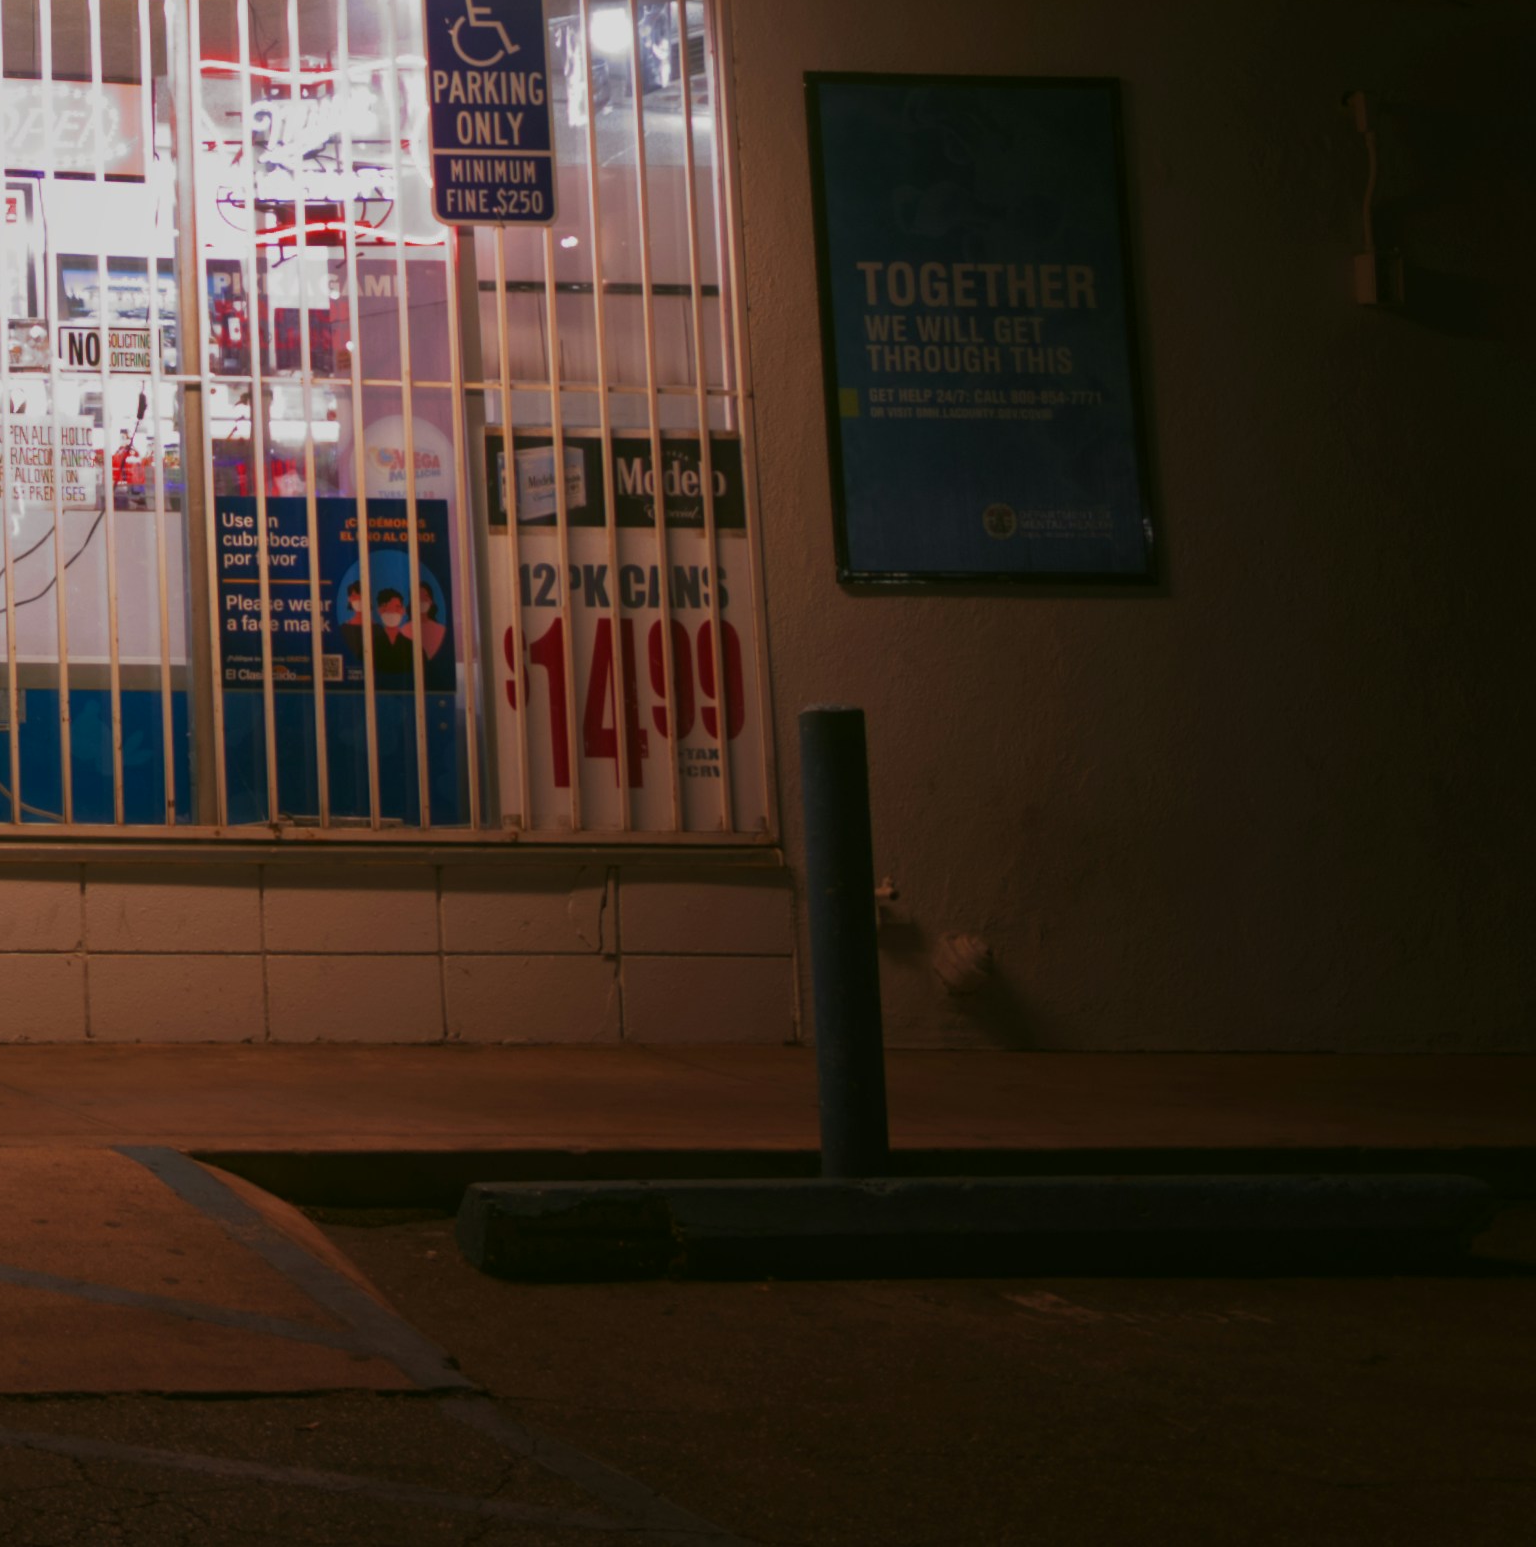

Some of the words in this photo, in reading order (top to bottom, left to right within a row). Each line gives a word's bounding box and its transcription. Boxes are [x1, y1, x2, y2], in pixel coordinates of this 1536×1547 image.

[433, 70, 544, 106] PARKING
[456, 110, 524, 145] ONLY
[450, 159, 536, 184] MINIMUM
[446, 188, 489, 212] FINE
[496, 187, 543, 216] $250
[856, 261, 1097, 309] TOGETHER
[864, 314, 907, 342] WE
[916, 315, 984, 343] WILL
[993, 316, 1044, 344] GET
[69, 331, 101, 367] NO
[108, 352, 151, 368] OITERING
[866, 345, 1001, 374] THROUGH
[1009, 346, 1073, 375] THIS
[869, 388, 895, 403] GET
[898, 388, 932, 403] HELP
[974, 389, 1008, 404] CALL
[31, 426, 93, 447] ALCHOLIC
[14, 467, 62, 484] ALLOWE
[617, 457, 727, 498] Modeo
[222, 513, 254, 528] Use
[224, 553, 251, 569] por
[520, 563, 611, 608] 12PK
[619, 564, 730, 610] CANS
[226, 594, 284, 612] Pleae
[289, 598, 332, 612] wer
[242, 615, 279, 632] fae
[284, 617, 332, 633] mak
